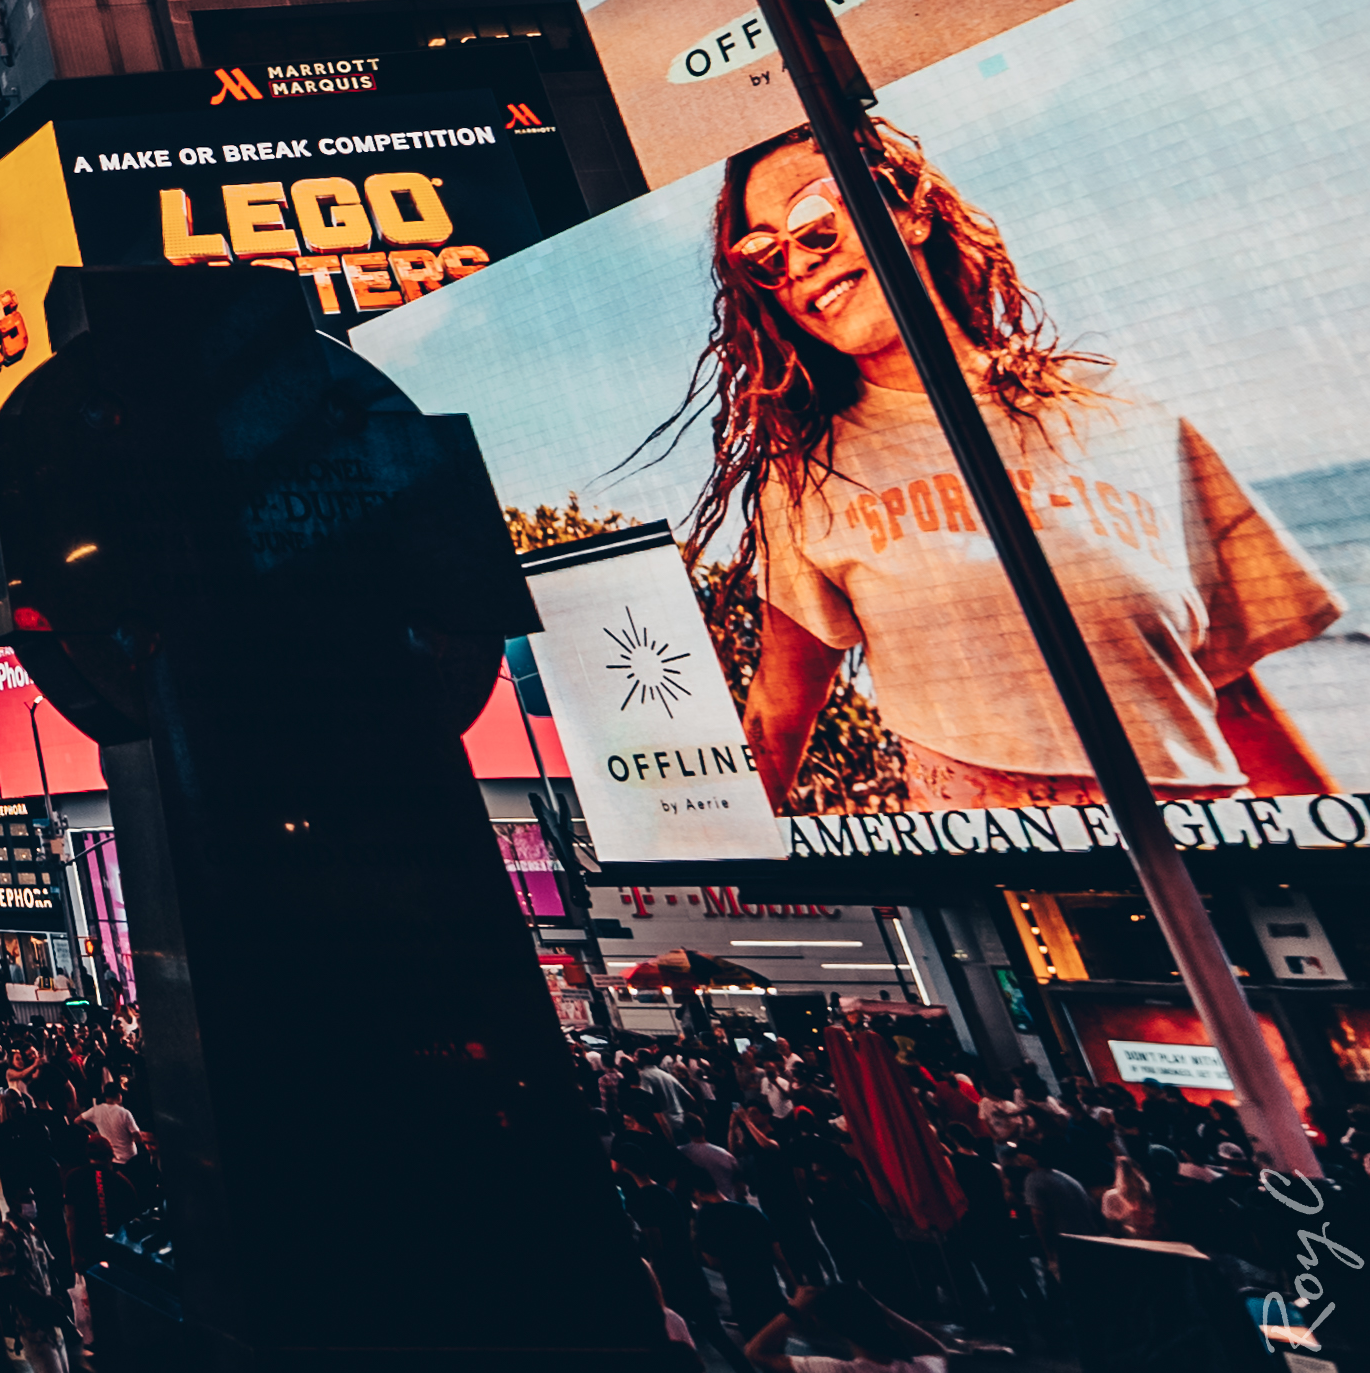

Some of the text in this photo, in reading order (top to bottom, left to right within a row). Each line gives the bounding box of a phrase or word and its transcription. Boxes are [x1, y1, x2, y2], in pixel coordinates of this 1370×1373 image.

[267, 58, 381, 79] MARRIOTT
[271, 73, 375, 96] MARQUIS
[74, 125, 496, 173] A MAKE OR BREAK COMPETITION
[159, 171, 454, 268] LEGO
[661, 796, 731, 815] by Aerie
[787, 794, 1297, 859] AMERICAN EGLE
